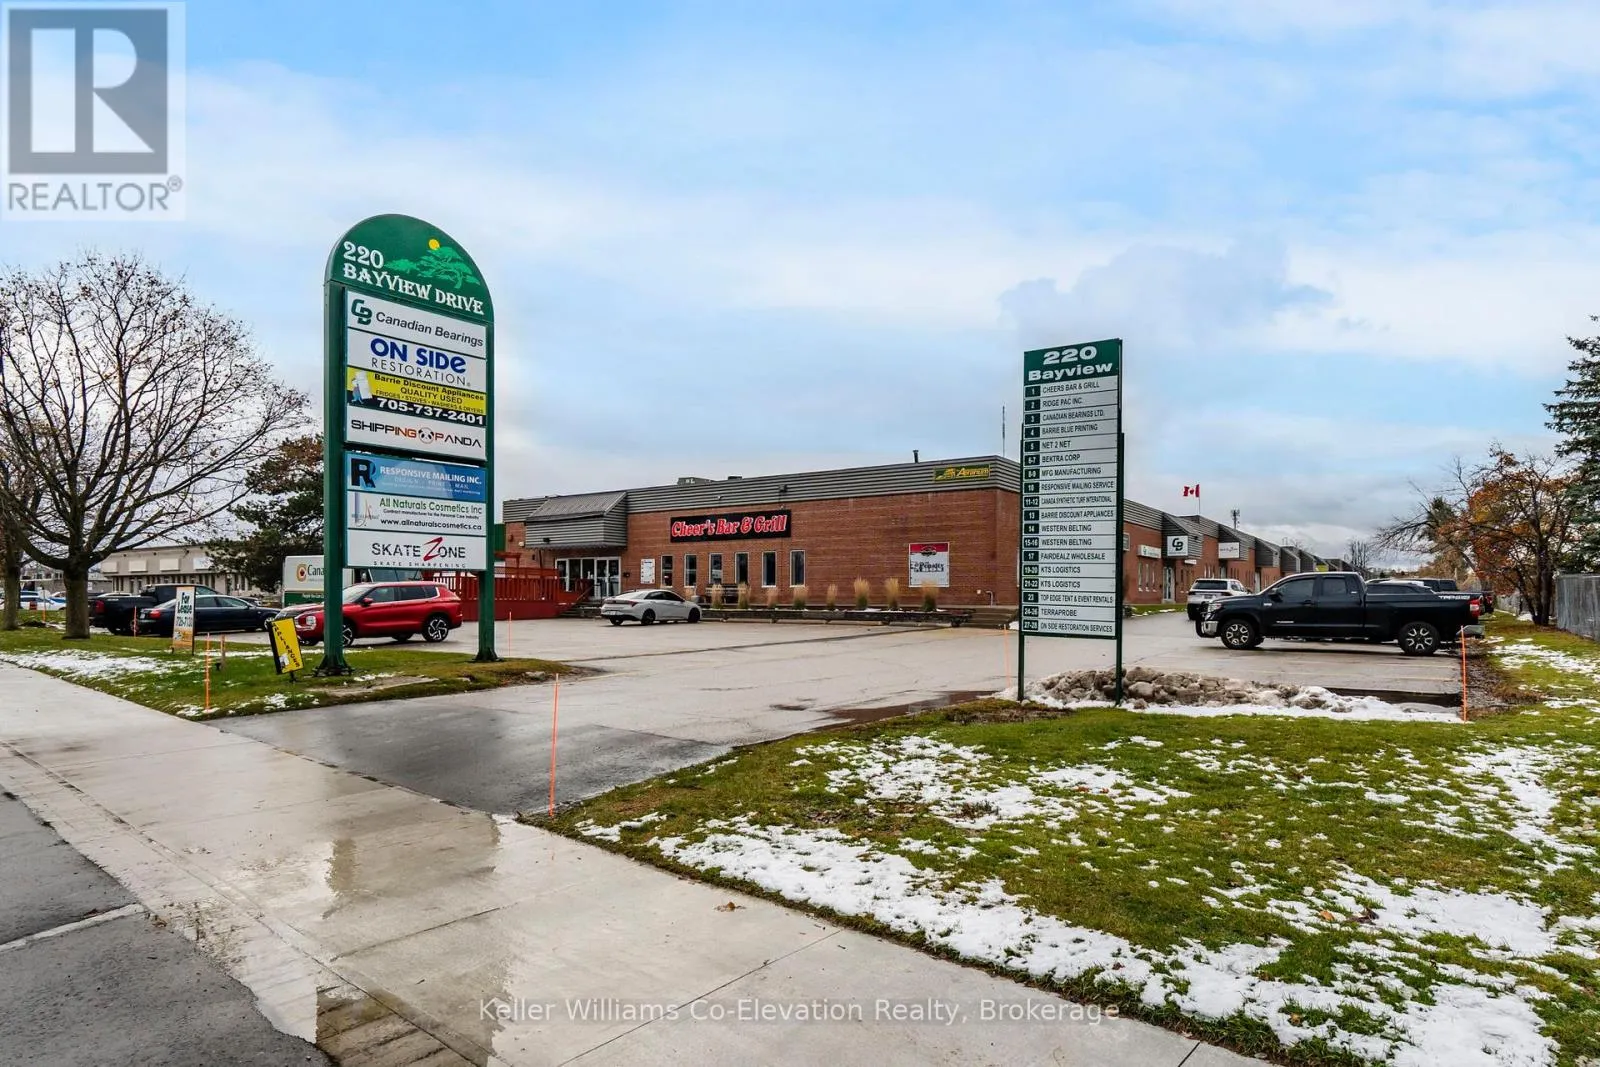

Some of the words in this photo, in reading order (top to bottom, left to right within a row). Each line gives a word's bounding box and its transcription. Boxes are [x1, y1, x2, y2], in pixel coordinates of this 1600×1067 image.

[343, 241, 384, 268] 220
[343, 263, 432, 300] BAYVIEW
[435, 288, 485, 315] DRIVE
[376, 312, 432, 334] Canadian
[434, 326, 484, 347] Bearings
[370, 338, 408, 362] ON
[1043, 346, 1097, 365] 220
[1028, 363, 1112, 381] Bayview
[374, 373, 401, 384] Barrie
[404, 380, 439, 392] Discount
[442, 388, 484, 400] Appliances
[1042, 385, 1064, 394] CHEERS
[376, 389, 403, 398] FRIDGES
[406, 394, 427, 404] STOVES
[432, 400, 458, 410] WASHERS
[464, 406, 484, 414] DRYERS
[400, 387, 437, 400] QUALITY
[440, 394, 462, 404] USED
[377, 398, 484, 424] 705-737-2401
[1042, 413, 1068, 421] CANADIAN
[351, 420, 417, 438] SHIPPING
[434, 432, 482, 448] PANDA
[1075, 424, 1098, 432] PRINTING
[380, 466, 431, 480] RESPONSIVE
[432, 472, 466, 482] MAILING
[466, 476, 482, 485] INC.
[1054, 467, 1101, 476] MANUFACTURING
[1042, 482, 1070, 490] RESPONSIVE
[1092, 480, 1114, 488] SERVICE
[380, 498, 391, 508] All
[393, 499, 426, 510] Naturals
[429, 502, 469, 513] Cosmetics
[471, 506, 482, 514] Inc
[1059, 510, 1083, 518] DISCOUNT
[1084, 510, 1114, 518] APPLIANCES
[380, 518, 482, 530] www.allnaturalscosmetics.ca
[672, 520, 715, 537] Cheer's
[716, 518, 740, 534] Bar
[740, 517, 754, 534] &
[754, 515, 788, 532] Grill
[372, 542, 421, 558] SKATE
[423, 536, 466, 561] ZONE
[308, 564, 326, 576] Cana
[178, 601, 192, 614] Lease
[1041, 608, 1077, 616] TERRAPROBE
[1059, 623, 1090, 632] RESTORATION
